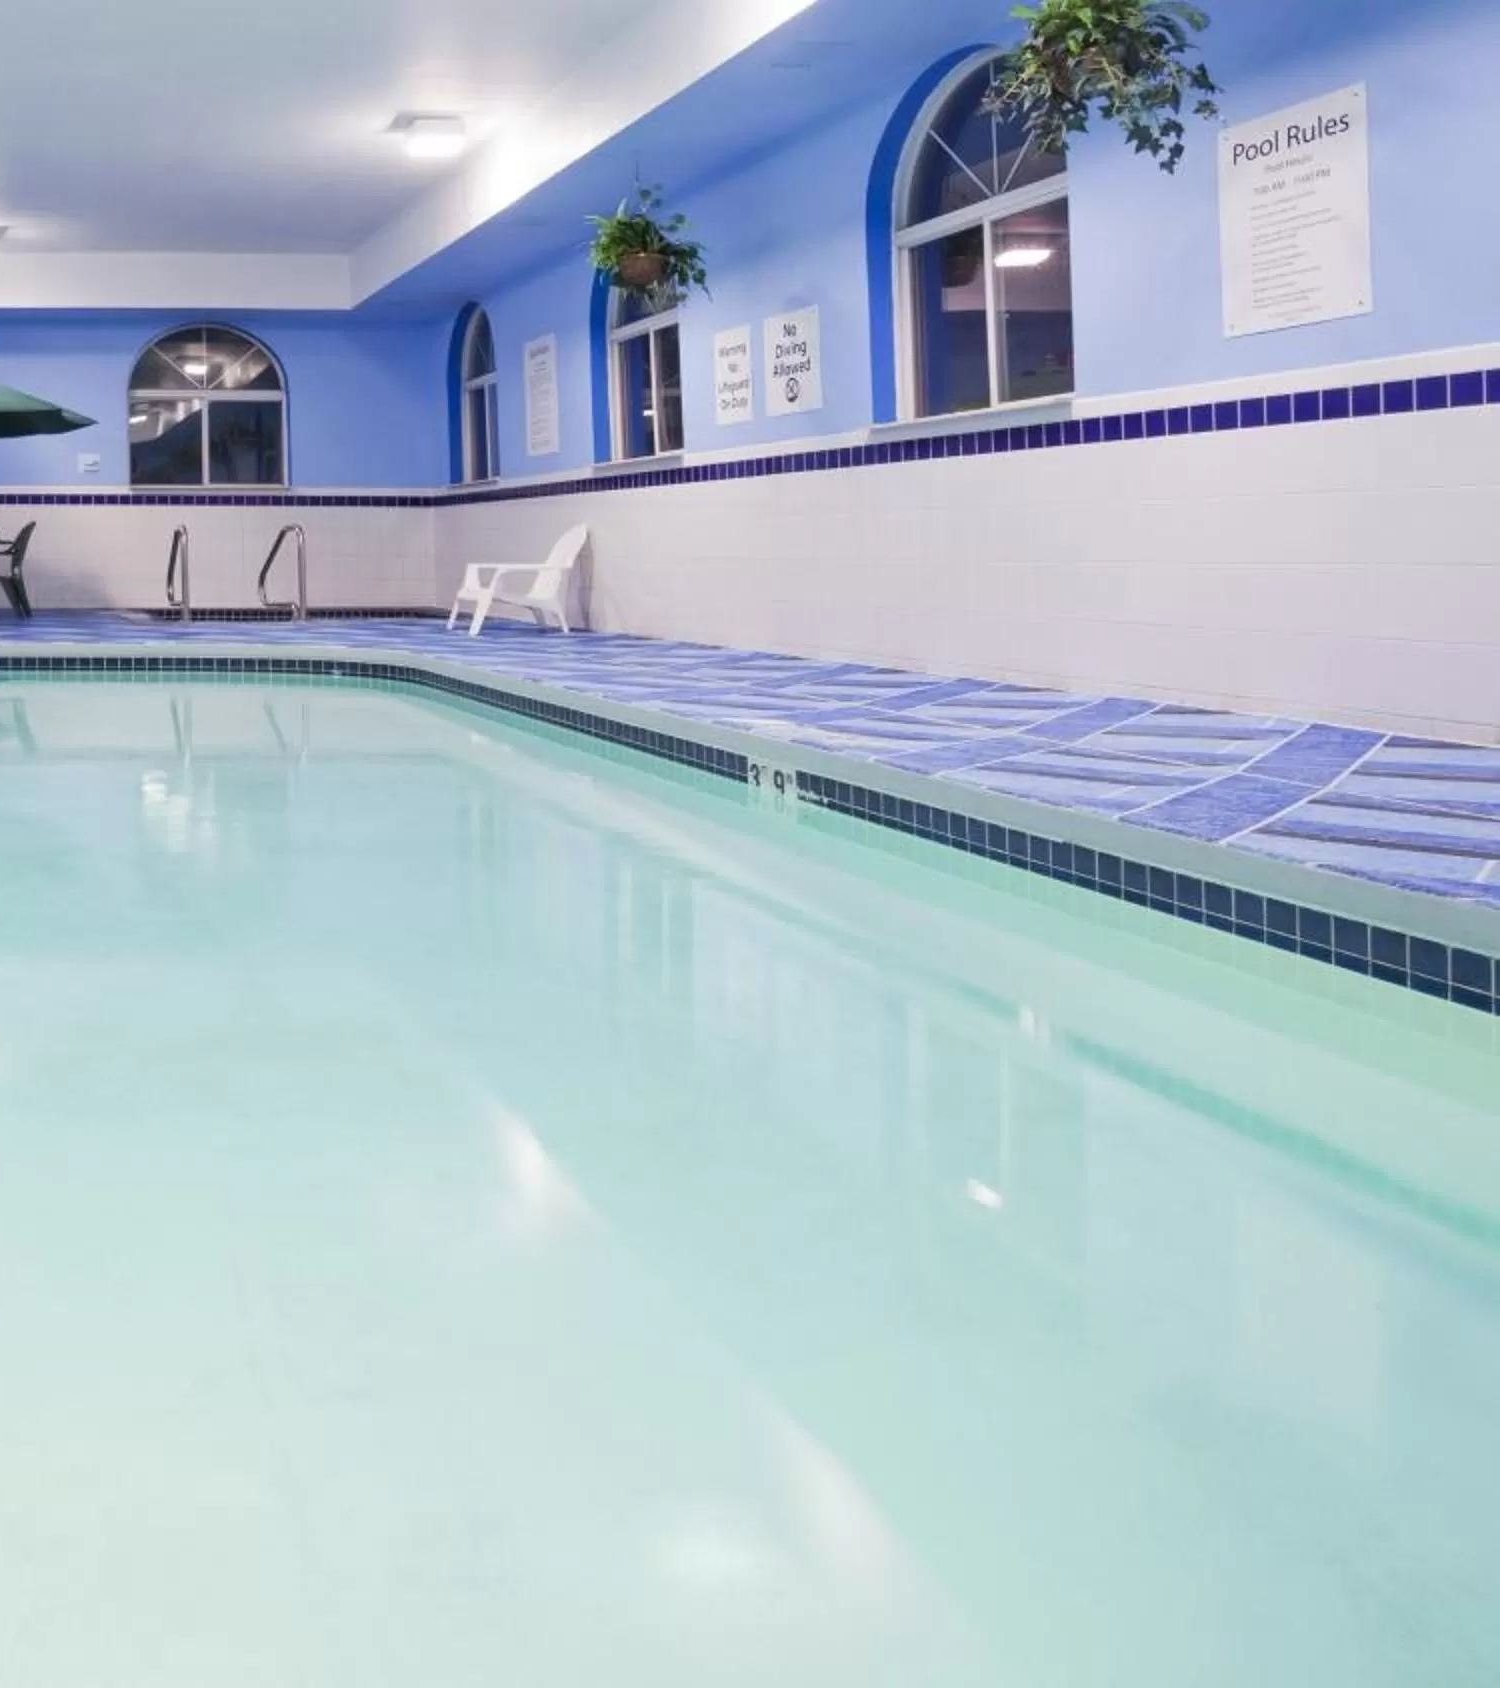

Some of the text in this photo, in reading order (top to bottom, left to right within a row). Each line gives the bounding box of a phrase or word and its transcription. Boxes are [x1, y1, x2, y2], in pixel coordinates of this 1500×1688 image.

[1233, 113, 1350, 166] Pool Rules
[783, 323, 797, 338] No
[775, 341, 807, 359] Diving
[773, 356, 811, 378] Allowed
